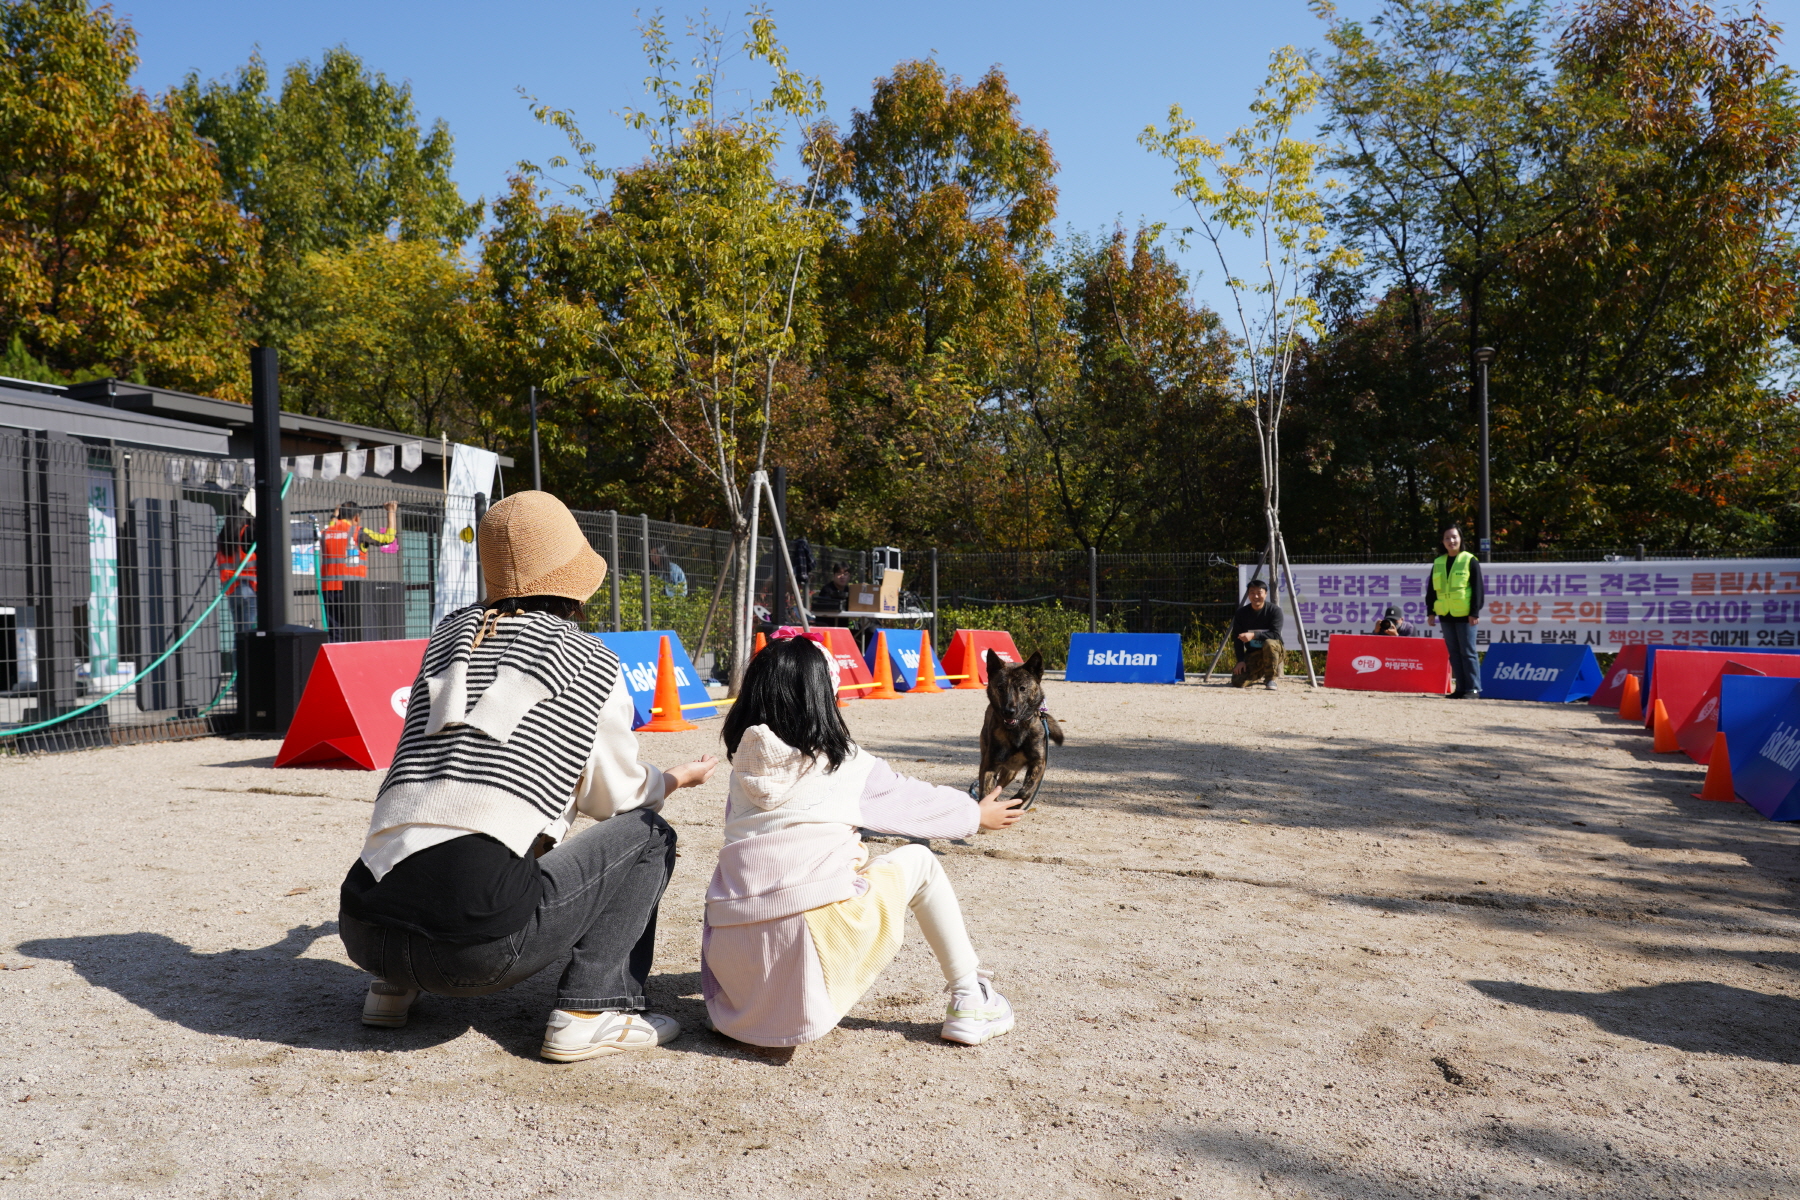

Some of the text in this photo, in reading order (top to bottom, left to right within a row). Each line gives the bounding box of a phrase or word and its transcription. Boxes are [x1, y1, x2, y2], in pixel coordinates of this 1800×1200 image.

[1318, 574, 1390, 597] 반려견
[1483, 573, 1588, 597] 내에서도
[1600, 573, 1679, 596] 견주는
[1488, 600, 1542, 625] 항상
[1551, 600, 1630, 625] 주의를
[1641, 600, 1751, 625] 기울여야
[1498, 630, 1533, 644] 사고
[1541, 630, 1577, 645] 발생
[1584, 630, 1601, 646] 시
[1608, 630, 1665, 646] 책임은
[1672, 630, 1749, 647] 견주에게
[1756, 629, 1800, 647] 있습
[1087, 649, 1158, 666] iskhan
[1357, 659, 1376, 669] 하림
[1384, 661, 1424, 671] 하림펫푸드
[1493, 662, 1560, 682] iskhan
